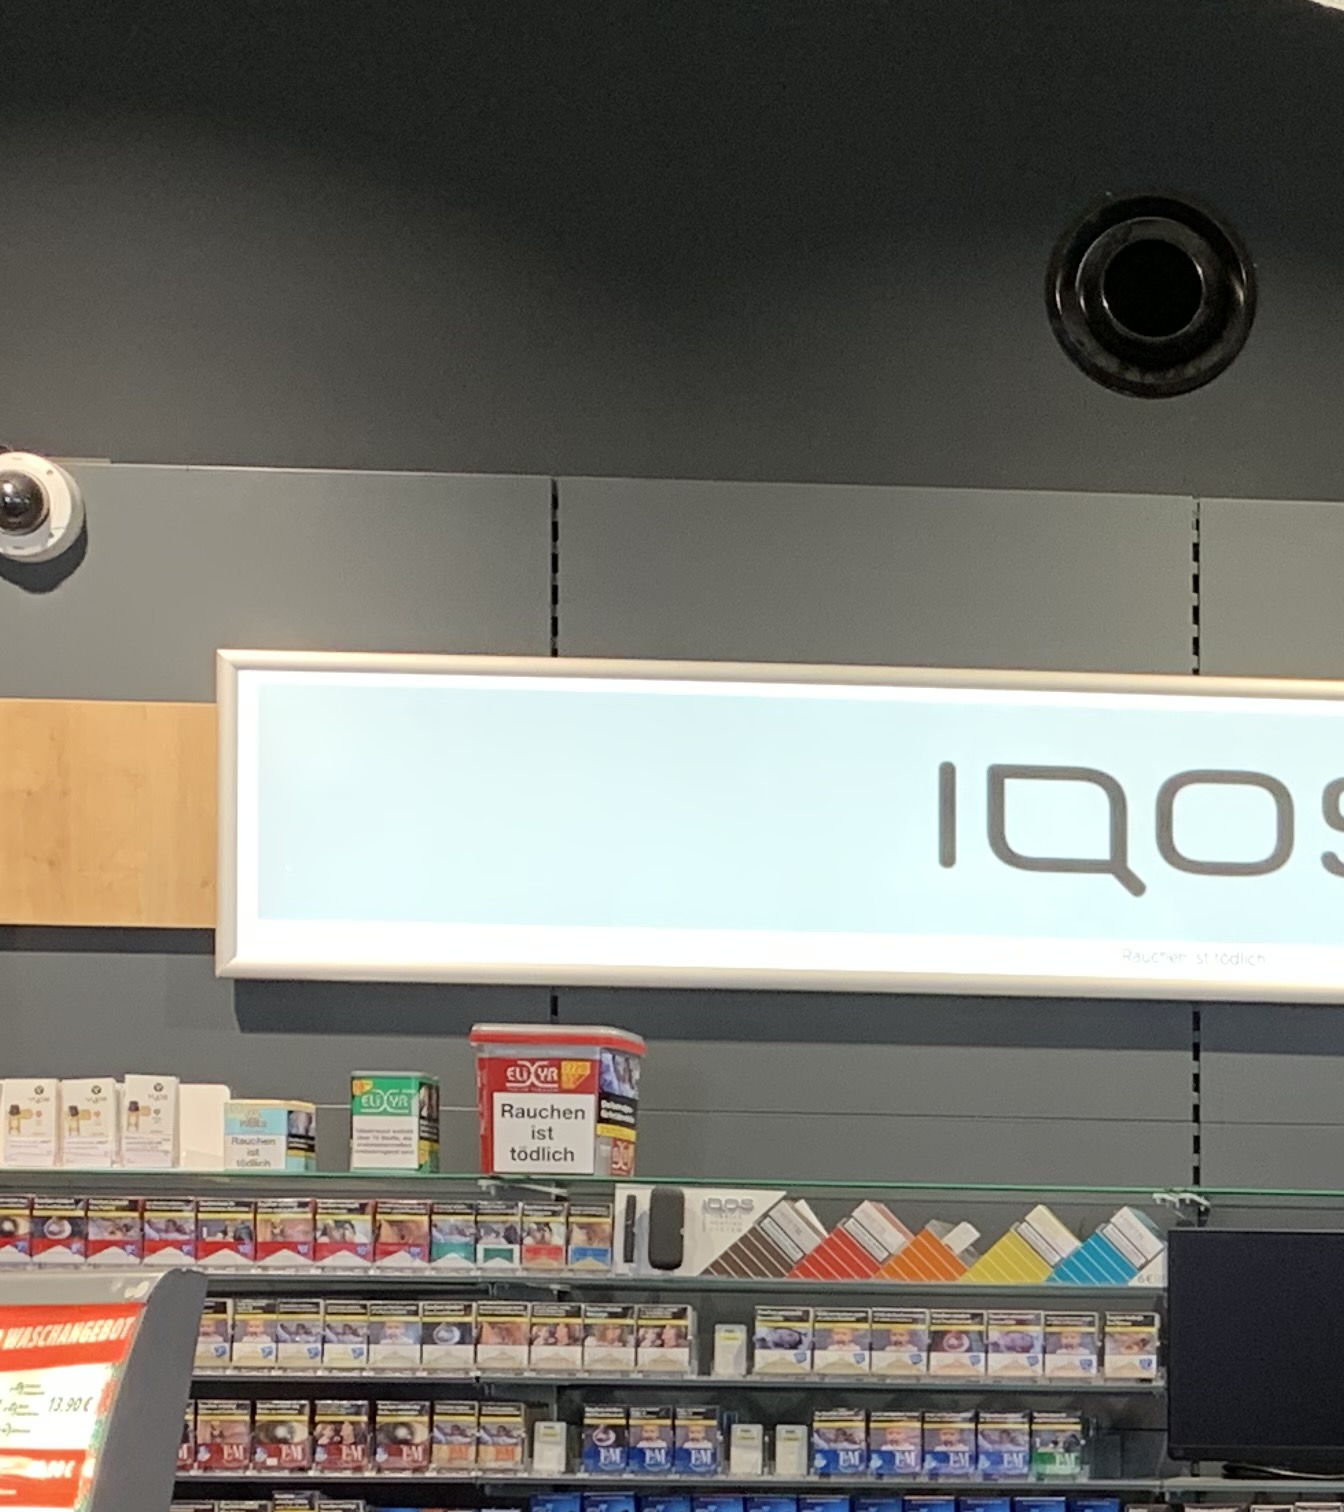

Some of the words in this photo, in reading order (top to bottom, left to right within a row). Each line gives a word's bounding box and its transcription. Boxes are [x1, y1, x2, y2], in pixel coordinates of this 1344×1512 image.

[500, 1104, 586, 1121] Rauchen
[530, 1124, 555, 1141] ist
[231, 1136, 276, 1147] Rauchen
[510, 1146, 575, 1163] tödlich
[3, 1316, 137, 1351] WASCHANGEBOT
[83, 1396, 94, 1411] €
